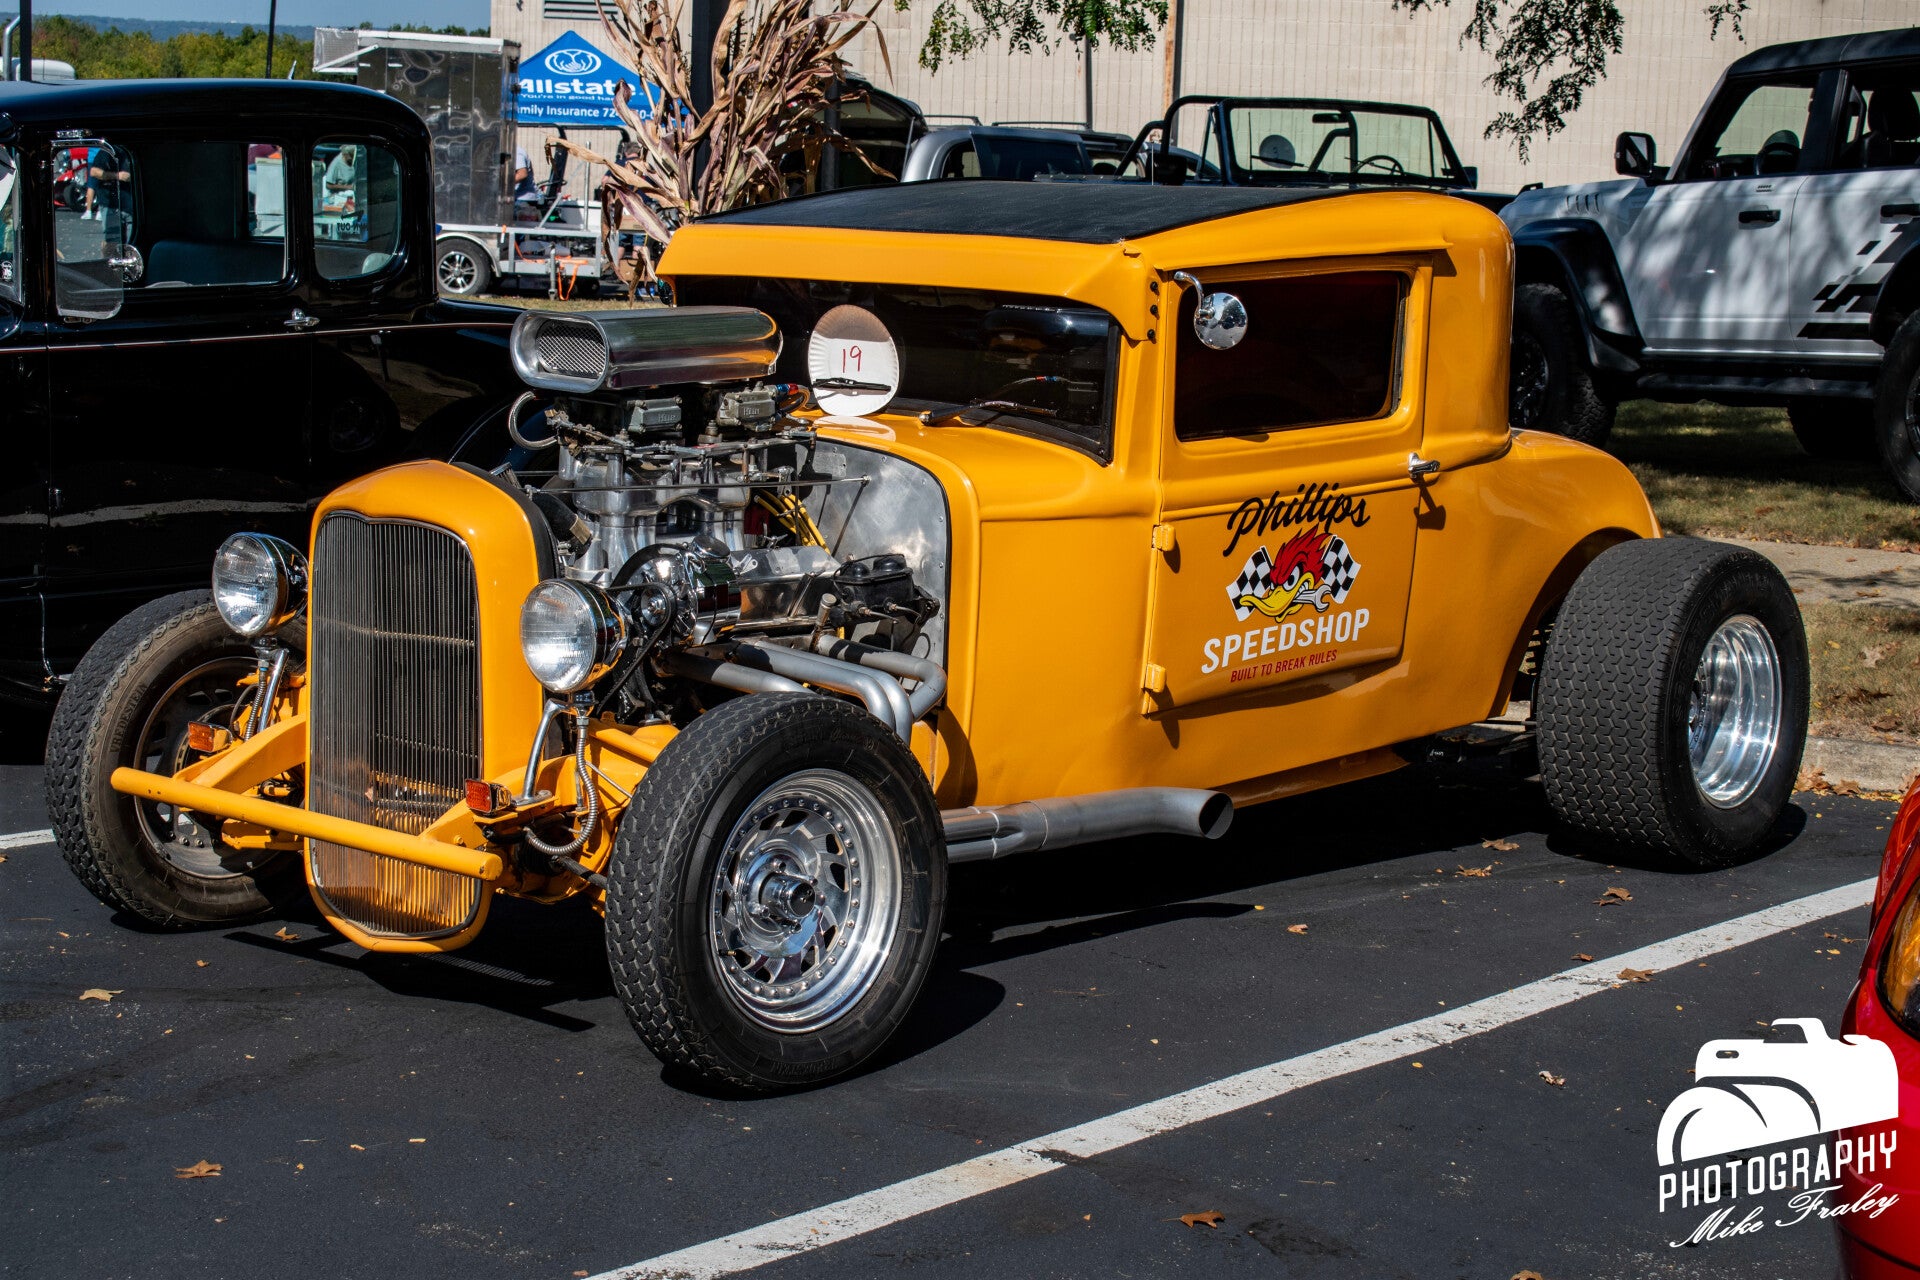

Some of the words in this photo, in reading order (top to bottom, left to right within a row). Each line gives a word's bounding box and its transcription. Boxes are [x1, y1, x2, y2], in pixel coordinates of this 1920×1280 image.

[519, 78, 637, 95] Allstat
[546, 105, 600, 118] Insurance
[842, 345, 862, 374] 19
[1222, 482, 1371, 557] Phillips
[1201, 608, 1370, 674] SPEEDSHOP
[1231, 665, 1258, 683] BUILT
[1260, 663, 1273, 677] TO
[1275, 656, 1308, 673] BREAK
[1308, 649, 1338, 666] RULES
